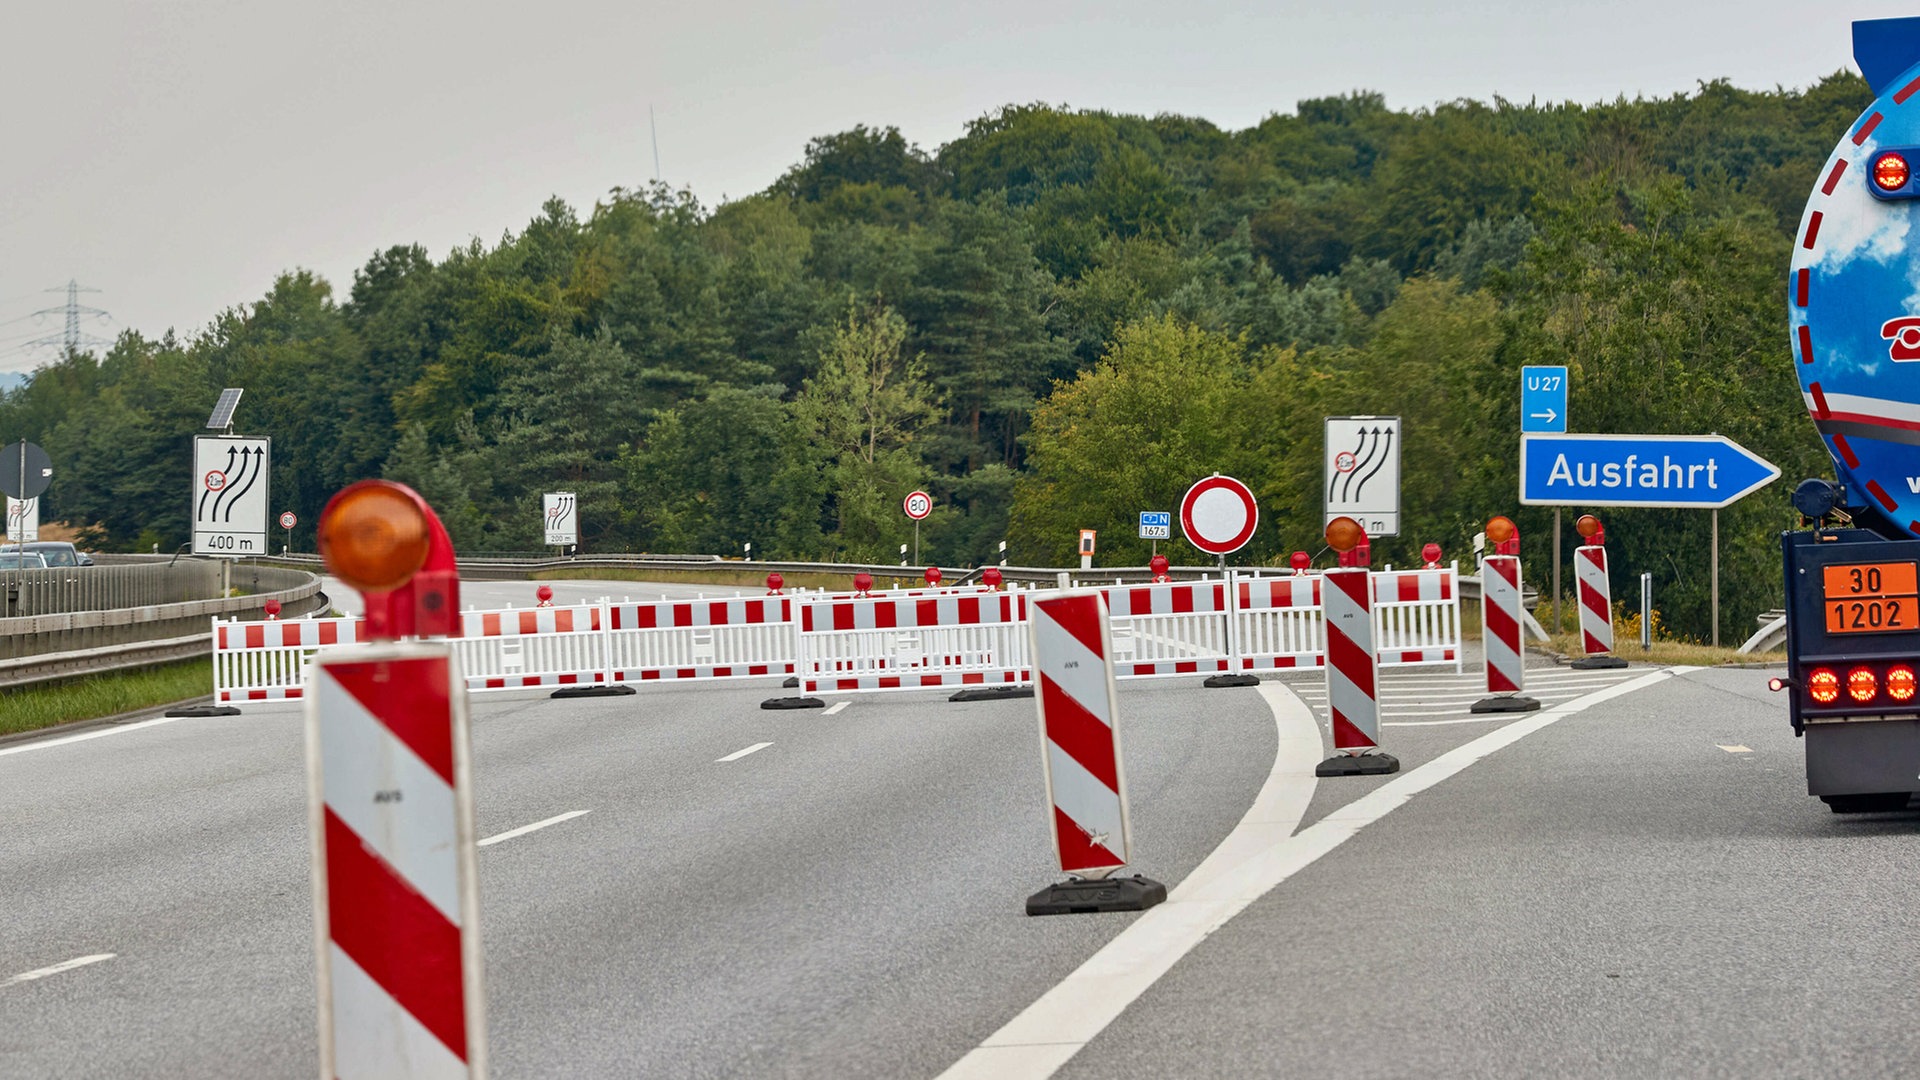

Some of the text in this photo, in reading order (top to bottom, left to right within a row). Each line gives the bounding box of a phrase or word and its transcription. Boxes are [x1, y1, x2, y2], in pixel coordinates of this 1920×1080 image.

[1546, 453, 1718, 489] Ausfahrt
[911, 499, 926, 511] 80
[284, 516, 293, 524] 80
[1160, 515, 1167, 524] N
[1371, 521, 1385, 532] m
[208, 535, 253, 550] 400 m
[1849, 567, 1882, 594] 30
[1834, 600, 1901, 629] 1202
